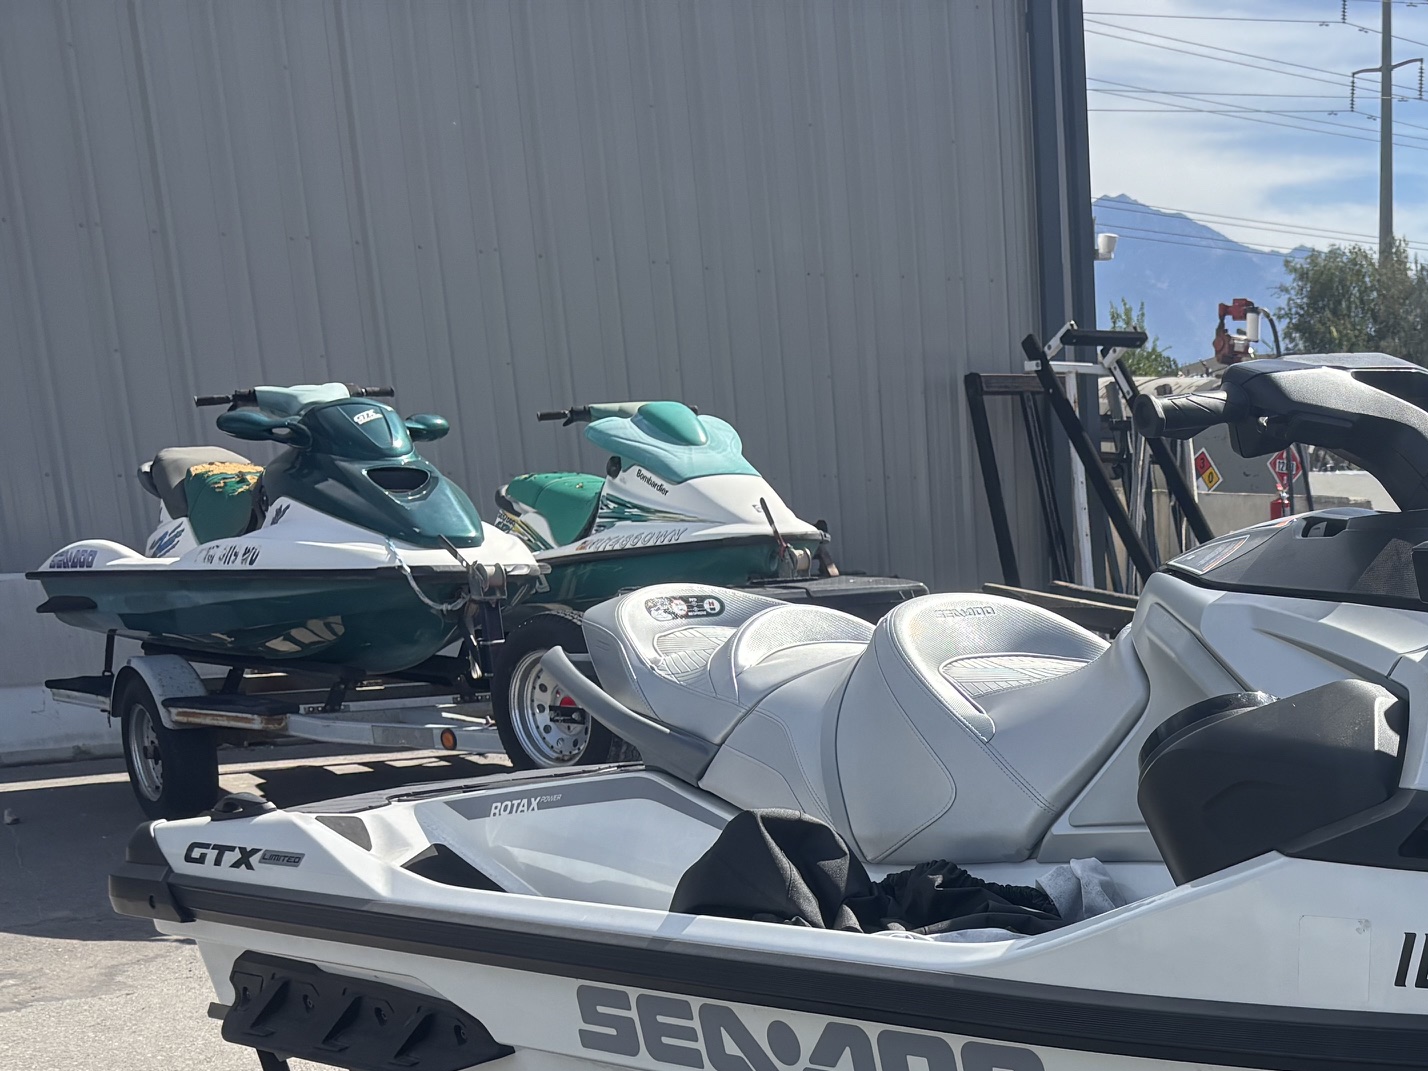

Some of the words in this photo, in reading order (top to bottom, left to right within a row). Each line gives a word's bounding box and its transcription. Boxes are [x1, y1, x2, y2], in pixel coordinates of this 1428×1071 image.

[636, 469, 669, 496] Bombardier
[489, 796, 541, 818] ROTAX
[540, 793, 563, 803] POWER
[184, 842, 263, 871] GTX
[262, 854, 301, 865] LIMITED
